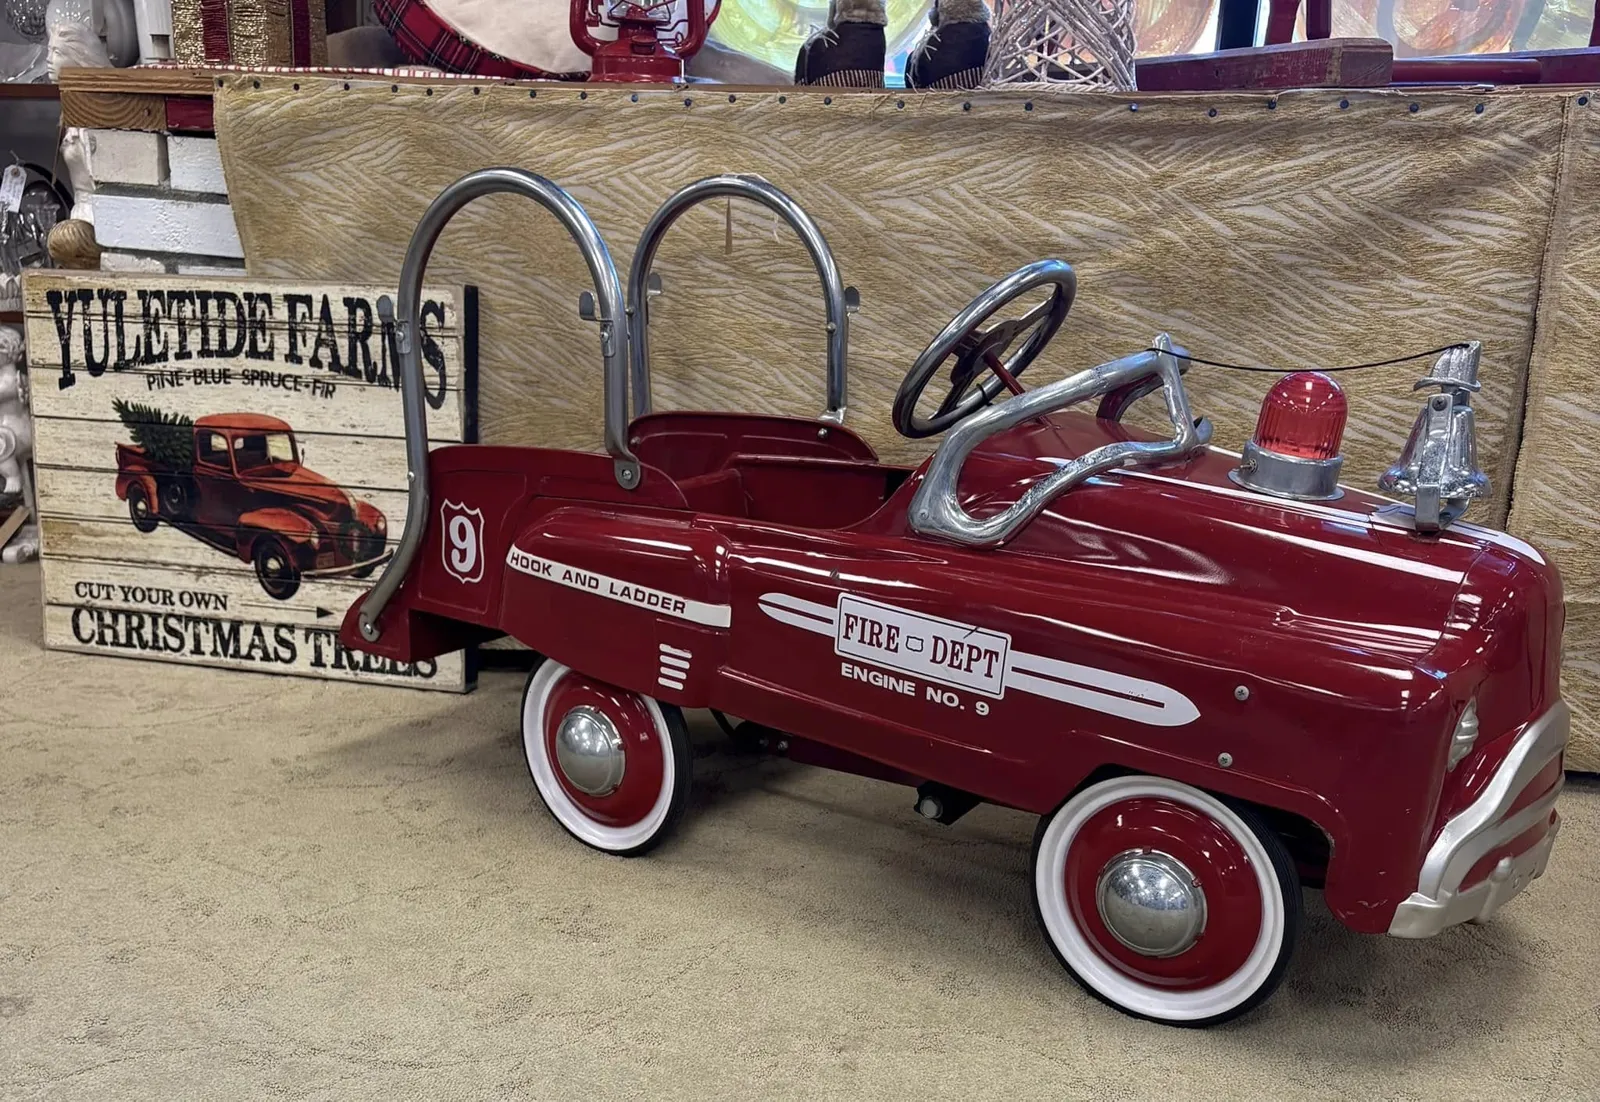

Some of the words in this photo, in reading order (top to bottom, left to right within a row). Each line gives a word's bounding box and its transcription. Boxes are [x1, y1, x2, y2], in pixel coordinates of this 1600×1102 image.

[46, 289, 275, 390] YULETIDE
[449, 515, 477, 573] 9
[75, 581, 115, 601] CUT
[118, 585, 175, 607] YOUR
[179, 590, 229, 611] OWN
[510, 552, 553, 577] HOOK
[562, 569, 599, 590] AND
[609, 582, 687, 614] LADDER
[71, 607, 298, 665] CHRISTMAS
[842, 612, 900, 653] FIRE
[930, 635, 1000, 679] DEPT
[841, 662, 916, 697] ENGINE
[926, 687, 965, 710] NO.
[975, 701, 990, 716] 9
